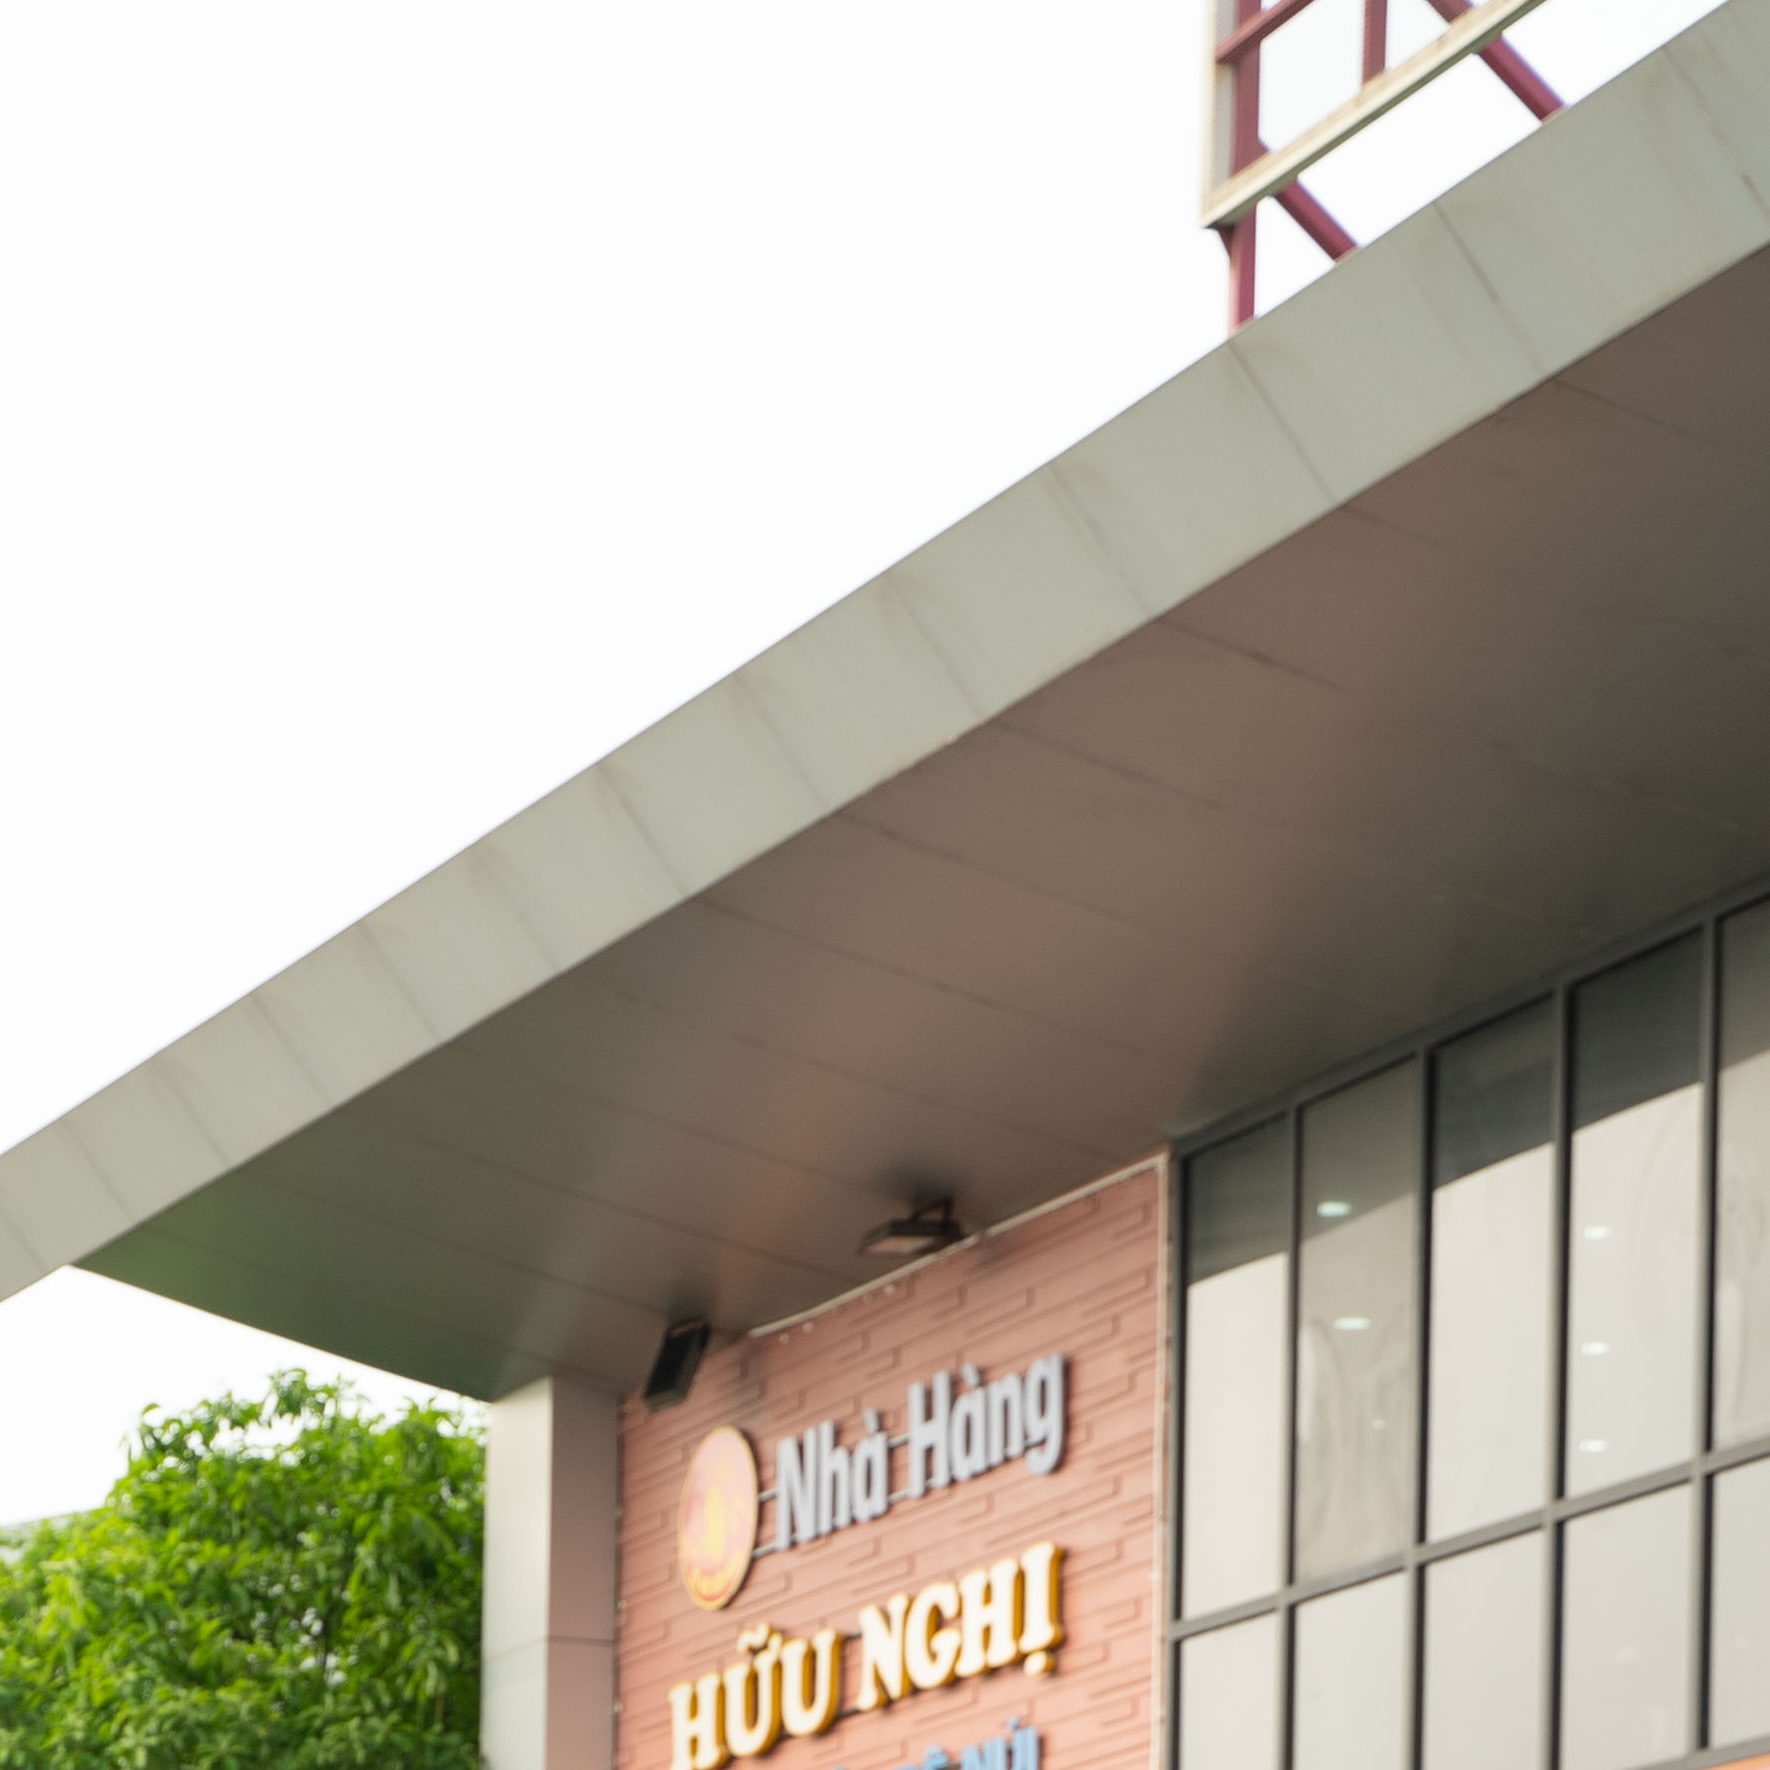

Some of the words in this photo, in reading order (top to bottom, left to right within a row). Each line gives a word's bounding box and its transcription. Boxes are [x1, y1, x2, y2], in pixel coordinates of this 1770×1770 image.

[775, 1407, 890, 1551] Nhà
[907, 1352, 1066, 1496] Hàng
[855, 1540, 1066, 1714] NGHỊ
